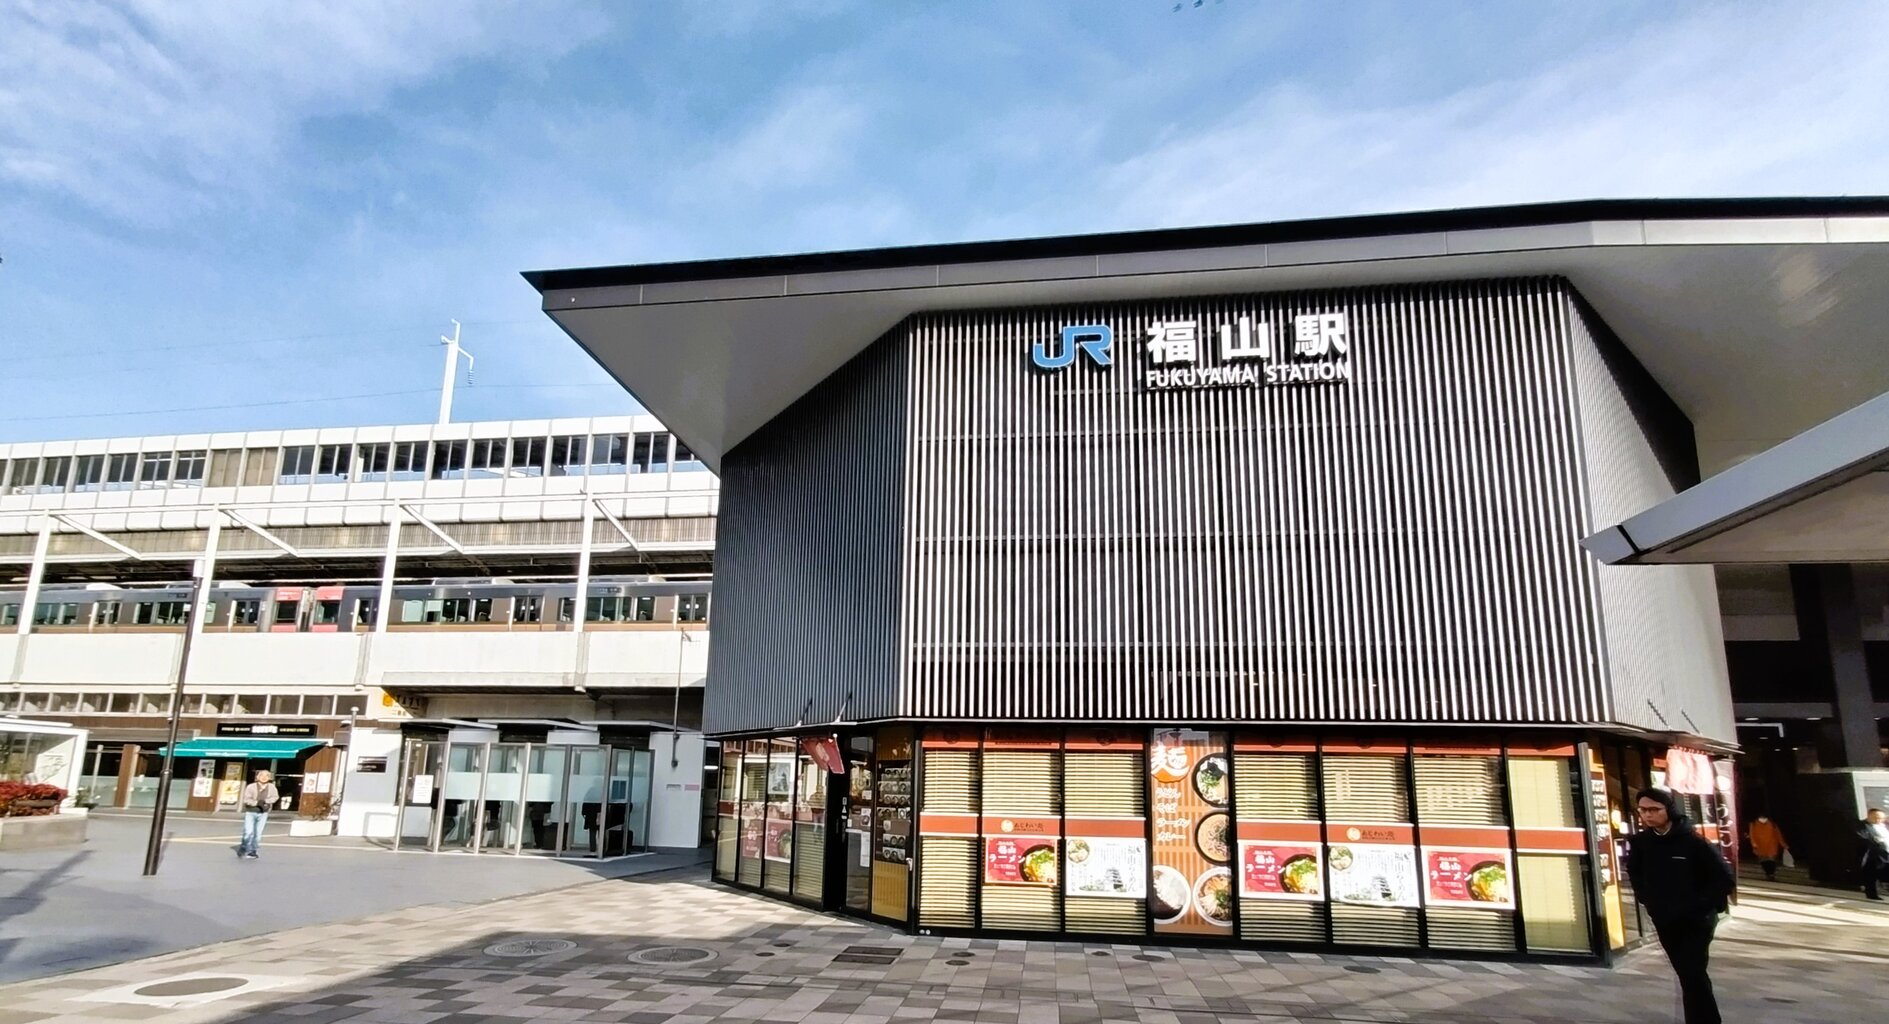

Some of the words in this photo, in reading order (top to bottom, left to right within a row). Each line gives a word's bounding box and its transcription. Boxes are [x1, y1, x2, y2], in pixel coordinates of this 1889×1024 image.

[1032, 324, 1113, 369] JR
[1146, 312, 1348, 364] 福山駅
[1146, 363, 1255, 388] FUKUYAMA
[1266, 361, 1349, 383] STATION
[1150, 741, 1190, 777] 麺
[989, 853, 1026, 864] ラーメン
[1245, 863, 1286, 874] ラーメン
[1430, 869, 1473, 881] ラーメン
